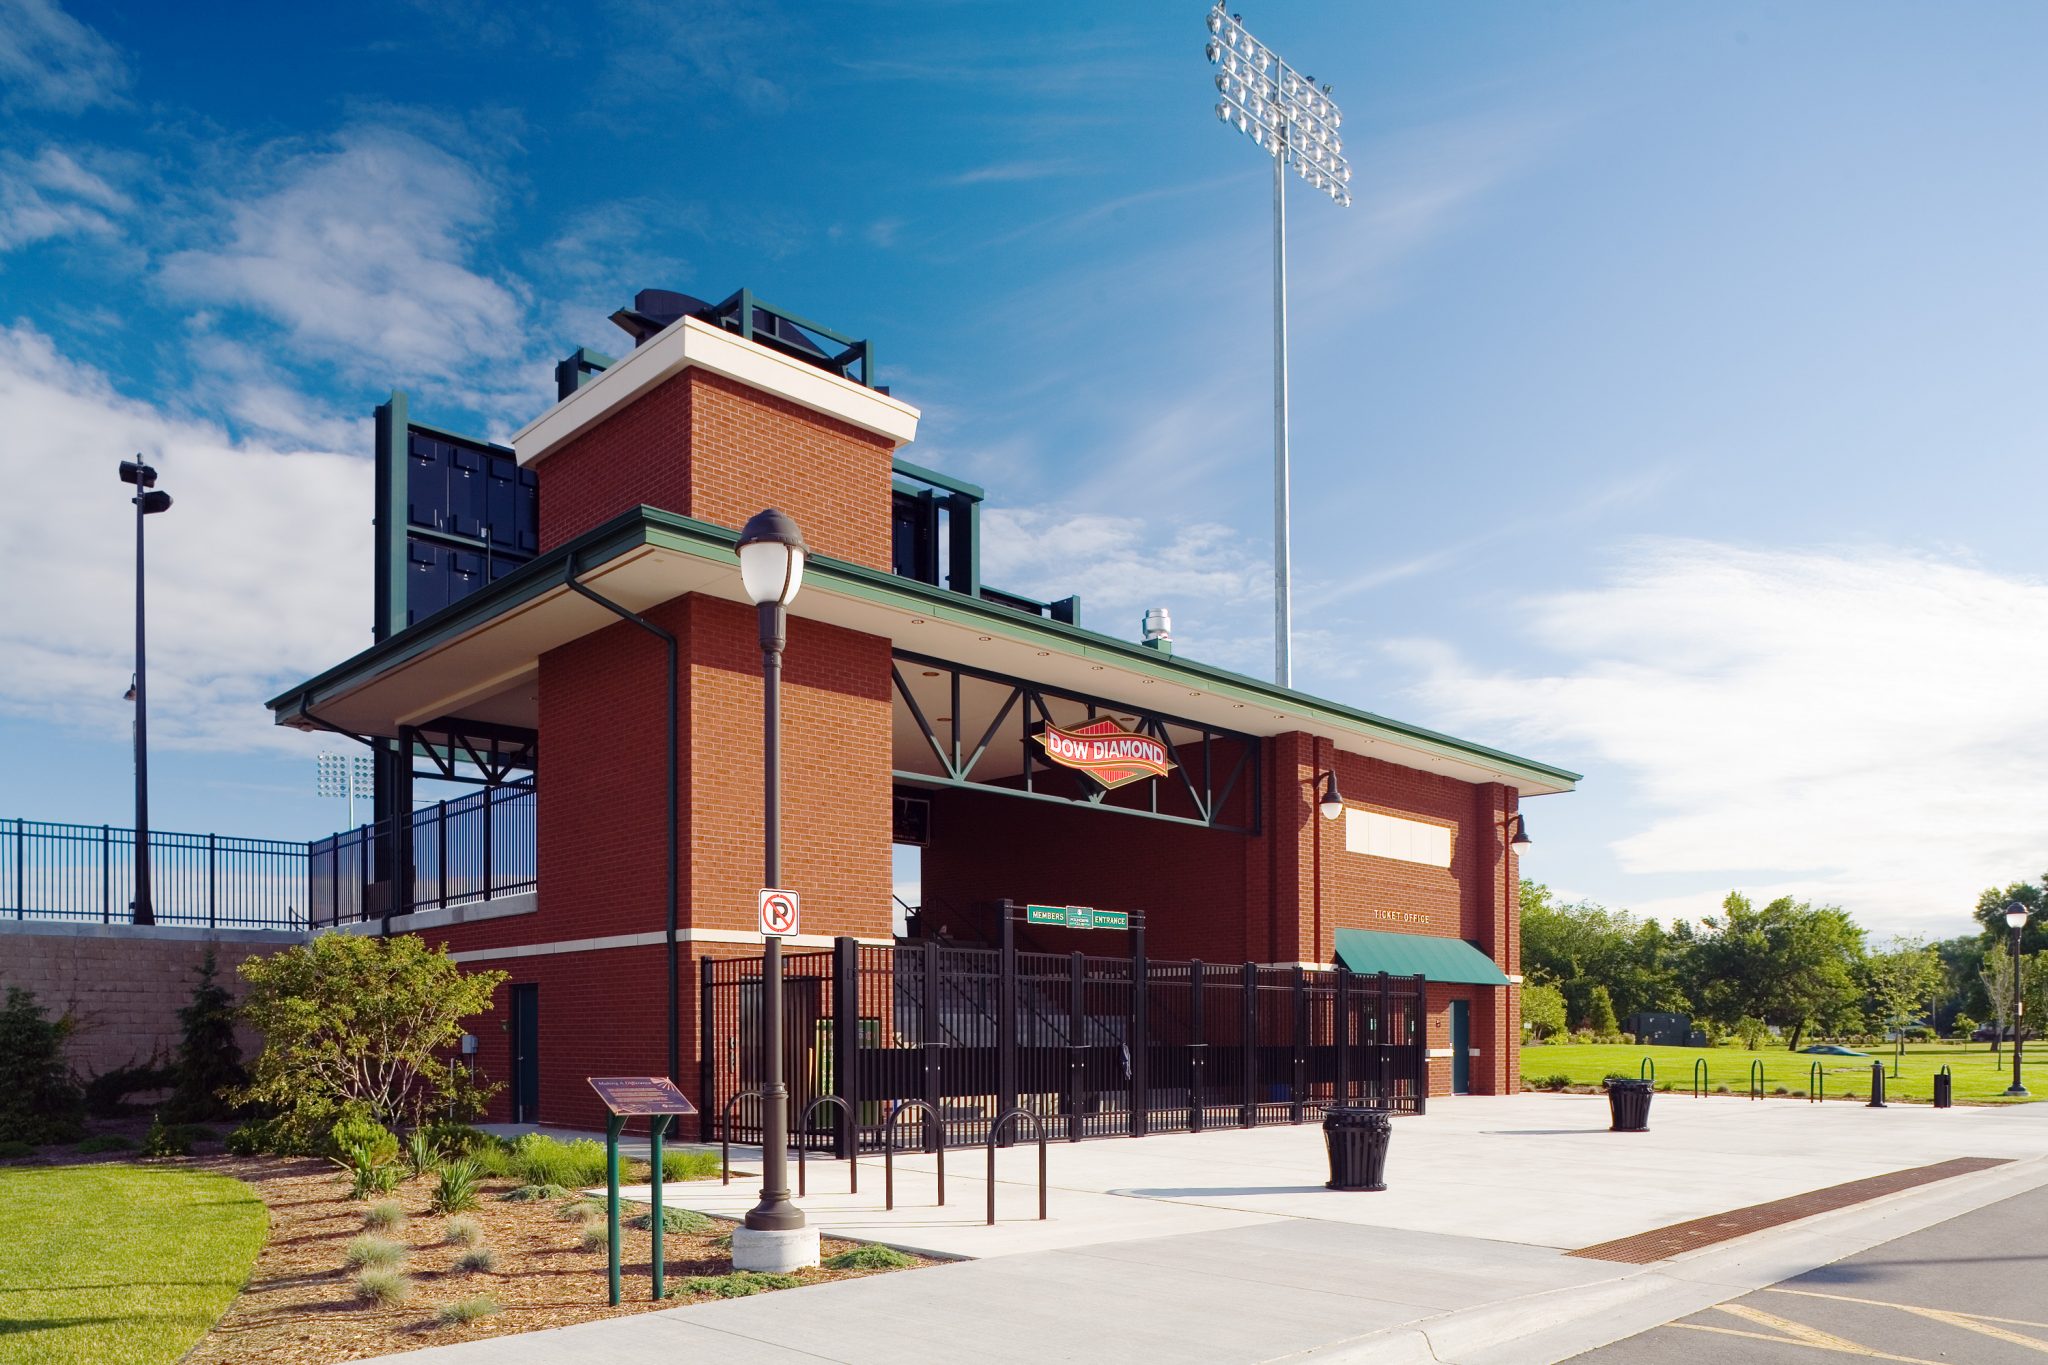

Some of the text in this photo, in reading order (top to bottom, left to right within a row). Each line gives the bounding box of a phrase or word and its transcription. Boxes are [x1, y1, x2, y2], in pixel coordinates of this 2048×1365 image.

[1049, 732, 1164, 765] DOW DIAMOND
[1033, 911, 1126, 925] MEMBERS ENTRANCE
[1374, 909, 1430, 924] TICKET OFFICE
